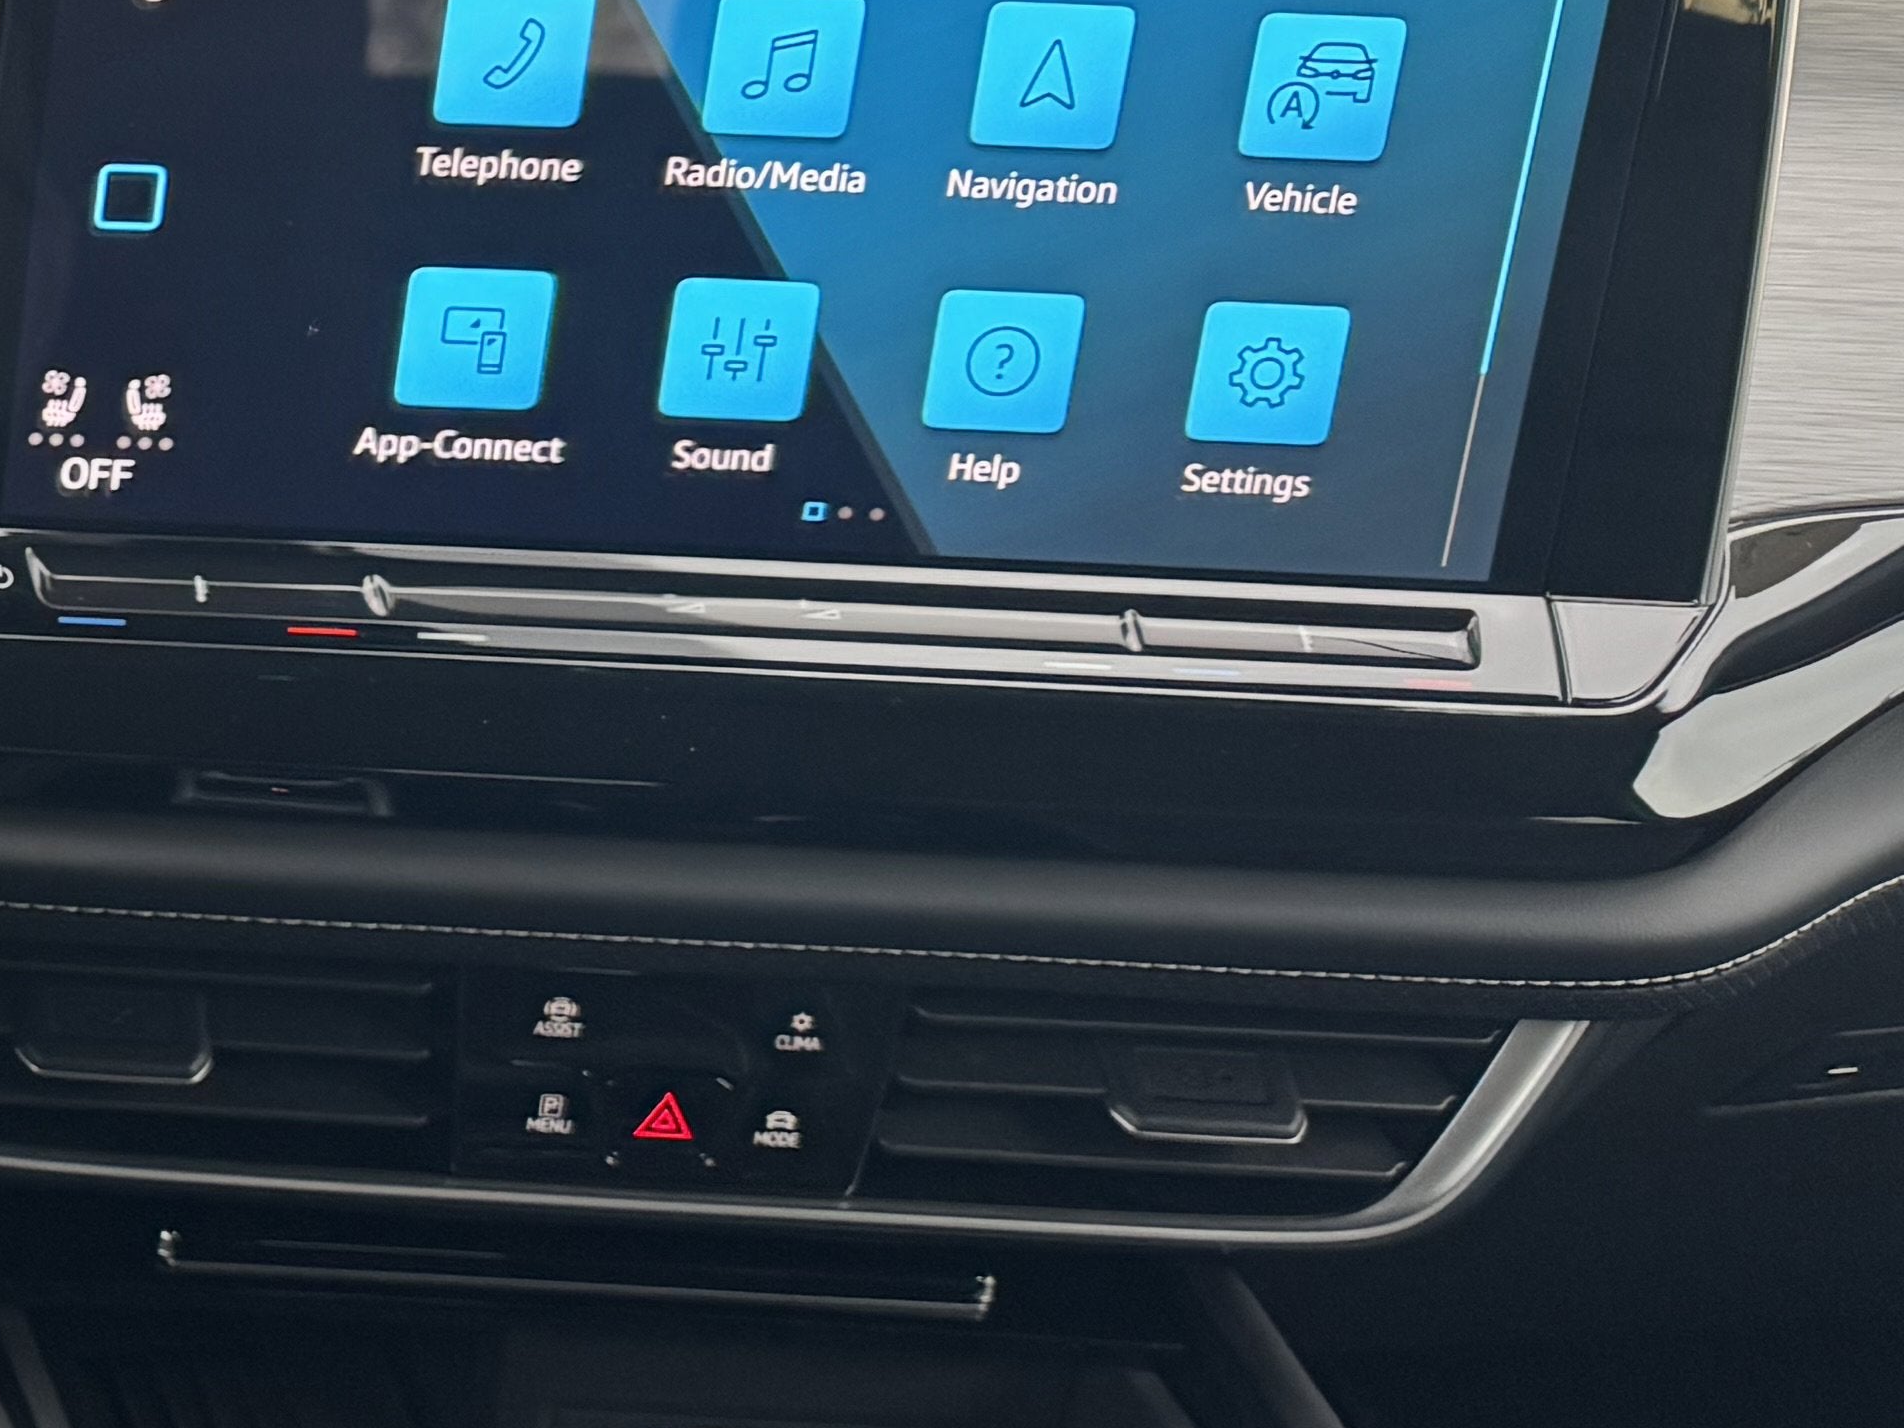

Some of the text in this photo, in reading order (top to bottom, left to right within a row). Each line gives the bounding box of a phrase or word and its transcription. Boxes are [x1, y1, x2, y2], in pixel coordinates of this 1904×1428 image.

[414, 145, 584, 187] Telephone
[664, 155, 867, 195] Radio/Media
[945, 168, 1119, 210] Navigation
[1244, 180, 1359, 217] Vehicle
[353, 425, 567, 465] App-Connect
[670, 439, 775, 473] Sound
[58, 456, 136, 491] OFF
[947, 452, 1021, 490] Help
[1180, 462, 1312, 504] Settings
[533, 1020, 584, 1039] ASSIST
[526, 1116, 575, 1136] MENU
[753, 1131, 802, 1149] MODE
